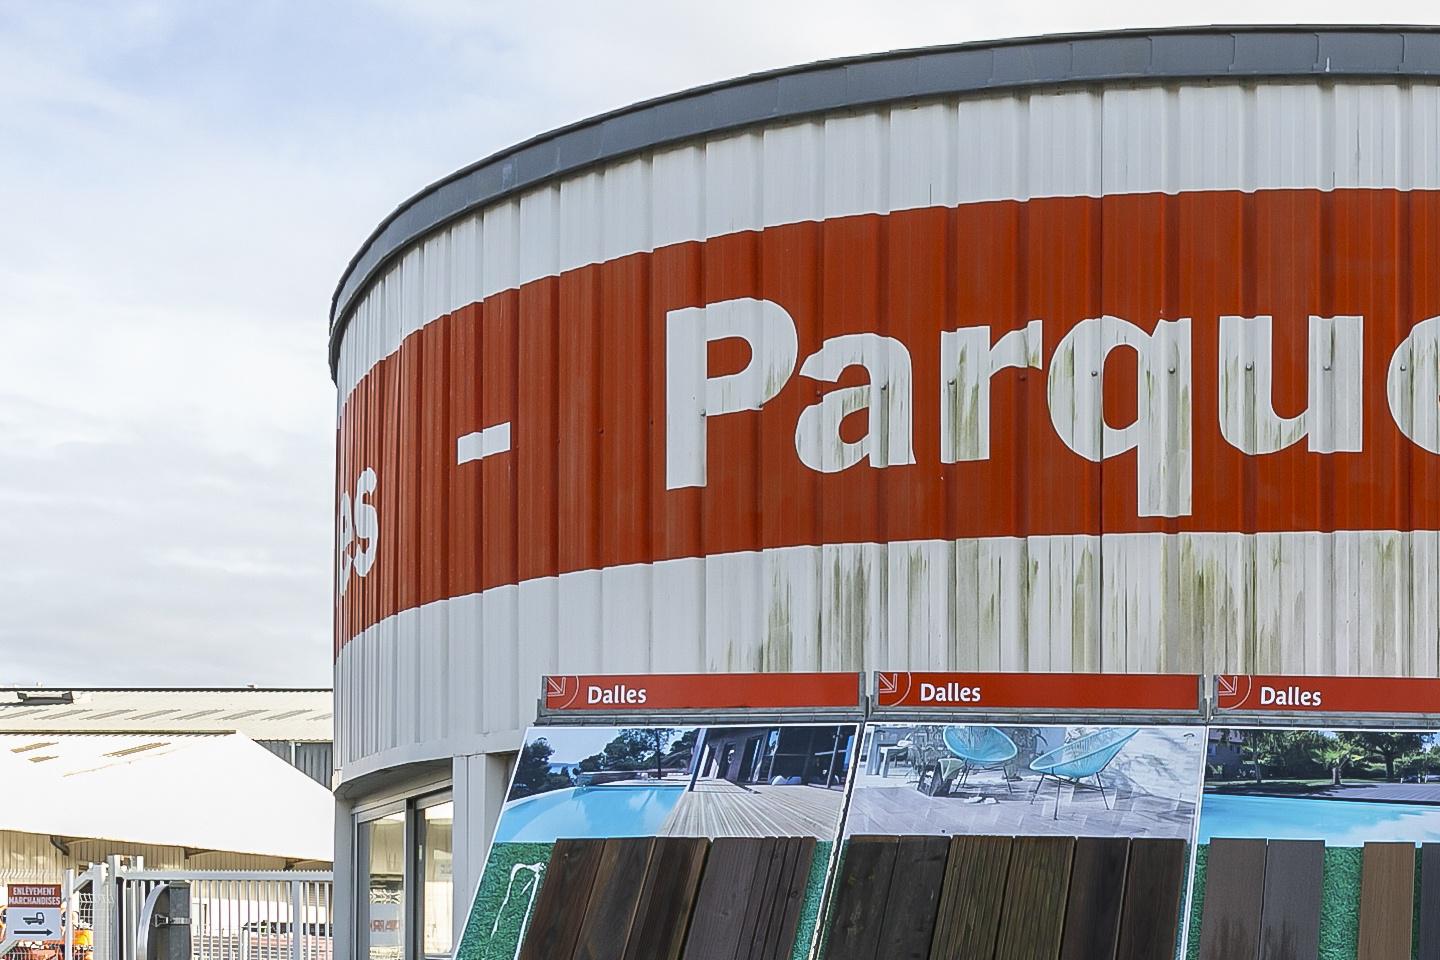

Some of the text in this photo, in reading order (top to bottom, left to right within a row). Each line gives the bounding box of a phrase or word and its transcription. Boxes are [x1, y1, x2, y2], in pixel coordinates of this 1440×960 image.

[587, 685, 647, 705] Dalles
[920, 682, 982, 703] Dalles
[1260, 686, 1322, 707] Dalles
[9, 896, 61, 906] MARCHANDISES
